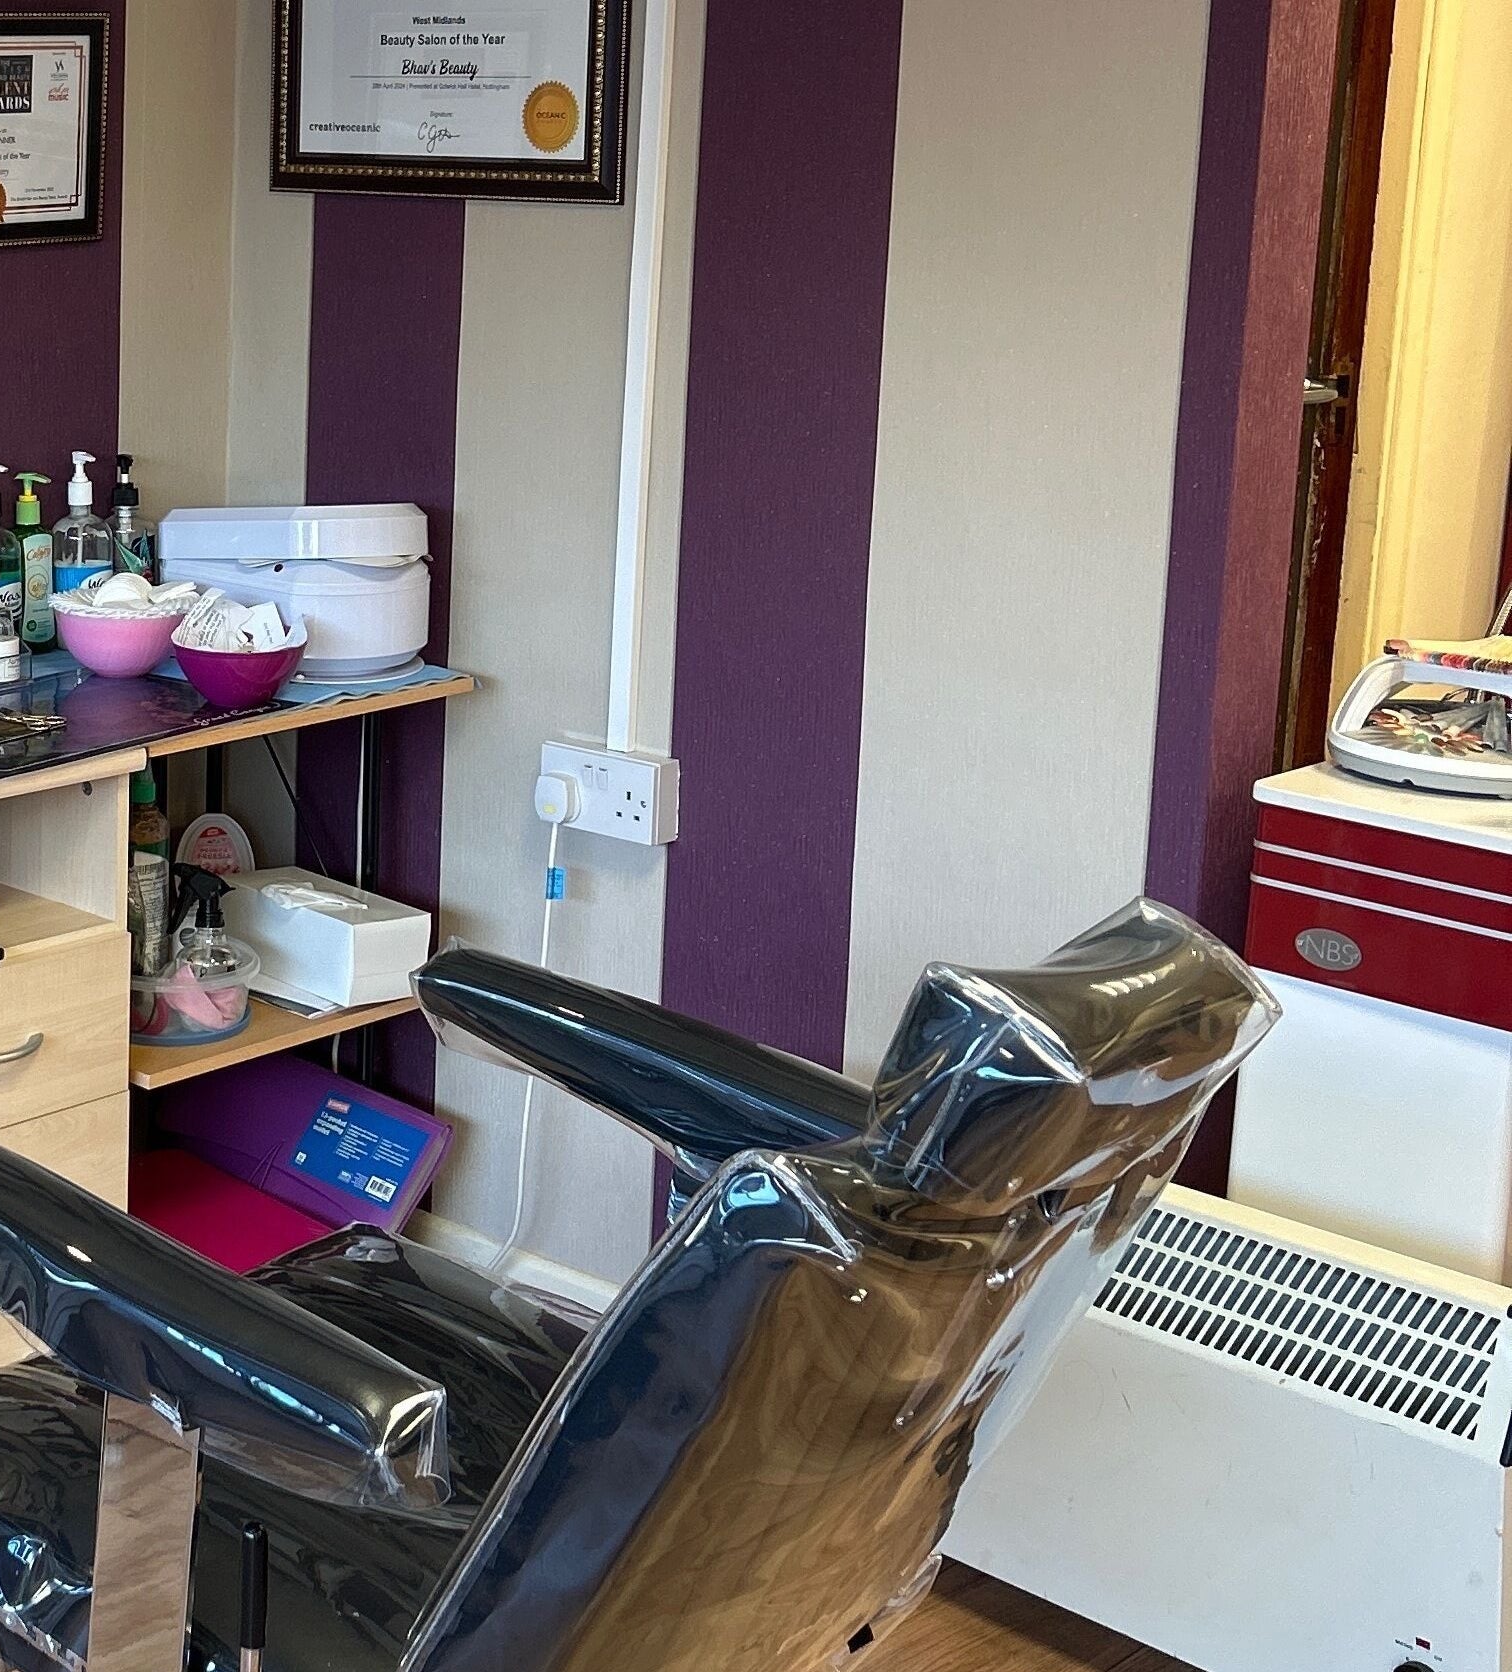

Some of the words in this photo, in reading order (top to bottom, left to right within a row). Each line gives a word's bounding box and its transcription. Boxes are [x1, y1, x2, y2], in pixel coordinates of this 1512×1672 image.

[411, 16, 431, 25] West
[432, 16, 466, 25] Midlands
[380, 34, 415, 48] Beauty
[417, 34, 447, 46] Salon
[449, 33, 461, 46] of
[462, 33, 479, 46] the
[481, 33, 506, 46] Year
[401, 58, 437, 76] Bhav's
[439, 58, 480, 81] Beauty
[308, 121, 382, 134] creativeoceanic
[1304, 934, 1355, 966] NBS
